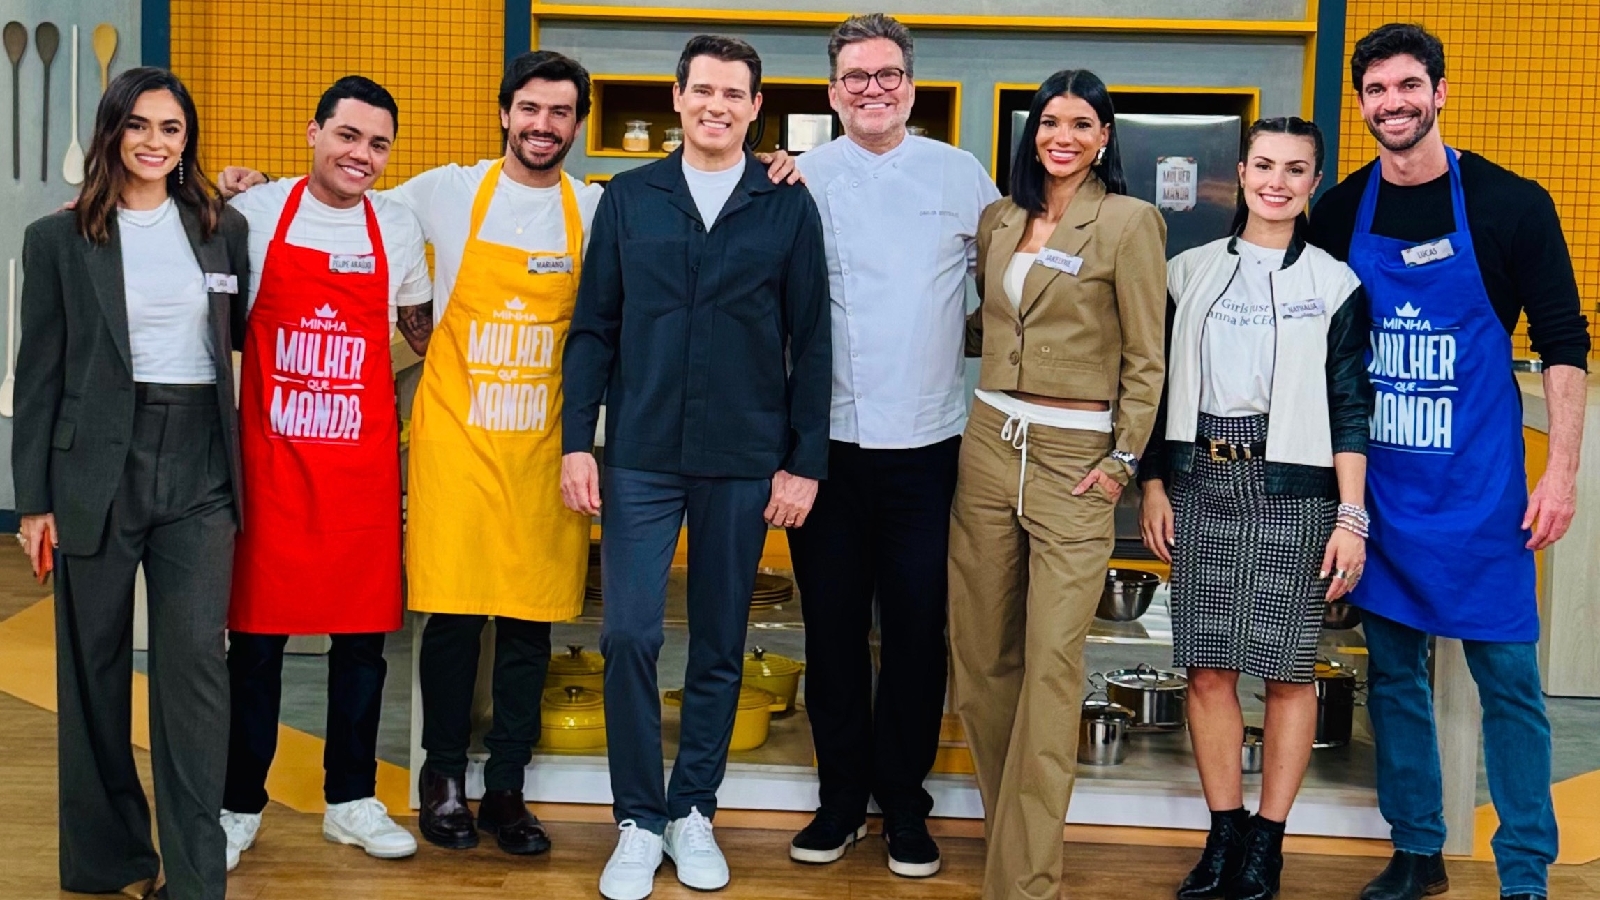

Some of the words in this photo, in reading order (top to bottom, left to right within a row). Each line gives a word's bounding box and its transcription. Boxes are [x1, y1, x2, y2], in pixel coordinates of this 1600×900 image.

[1162, 170, 1190, 183] MULHER
[1162, 187, 1189, 200] MANDA
[1417, 248, 1438, 259] LUCAS
[536, 261, 565, 269] MARIANO
[1221, 298, 1248, 314] Girls
[1248, 302, 1270, 315] just
[493, 309, 538, 322] MINHA
[1239, 315, 1251, 327] be
[300, 316, 348, 332] MINHA
[1383, 317, 1432, 331] MINHA
[467, 319, 554, 368] MULHER
[275, 327, 366, 380] MULHER
[1367, 330, 1456, 381] MULHER
[497, 369, 519, 381] QUE
[307, 379, 330, 391] QUE
[1394, 381, 1417, 393] QUE
[467, 379, 548, 431] MANDA
[270, 386, 362, 440] MANDA
[1368, 390, 1453, 448] MANDA
